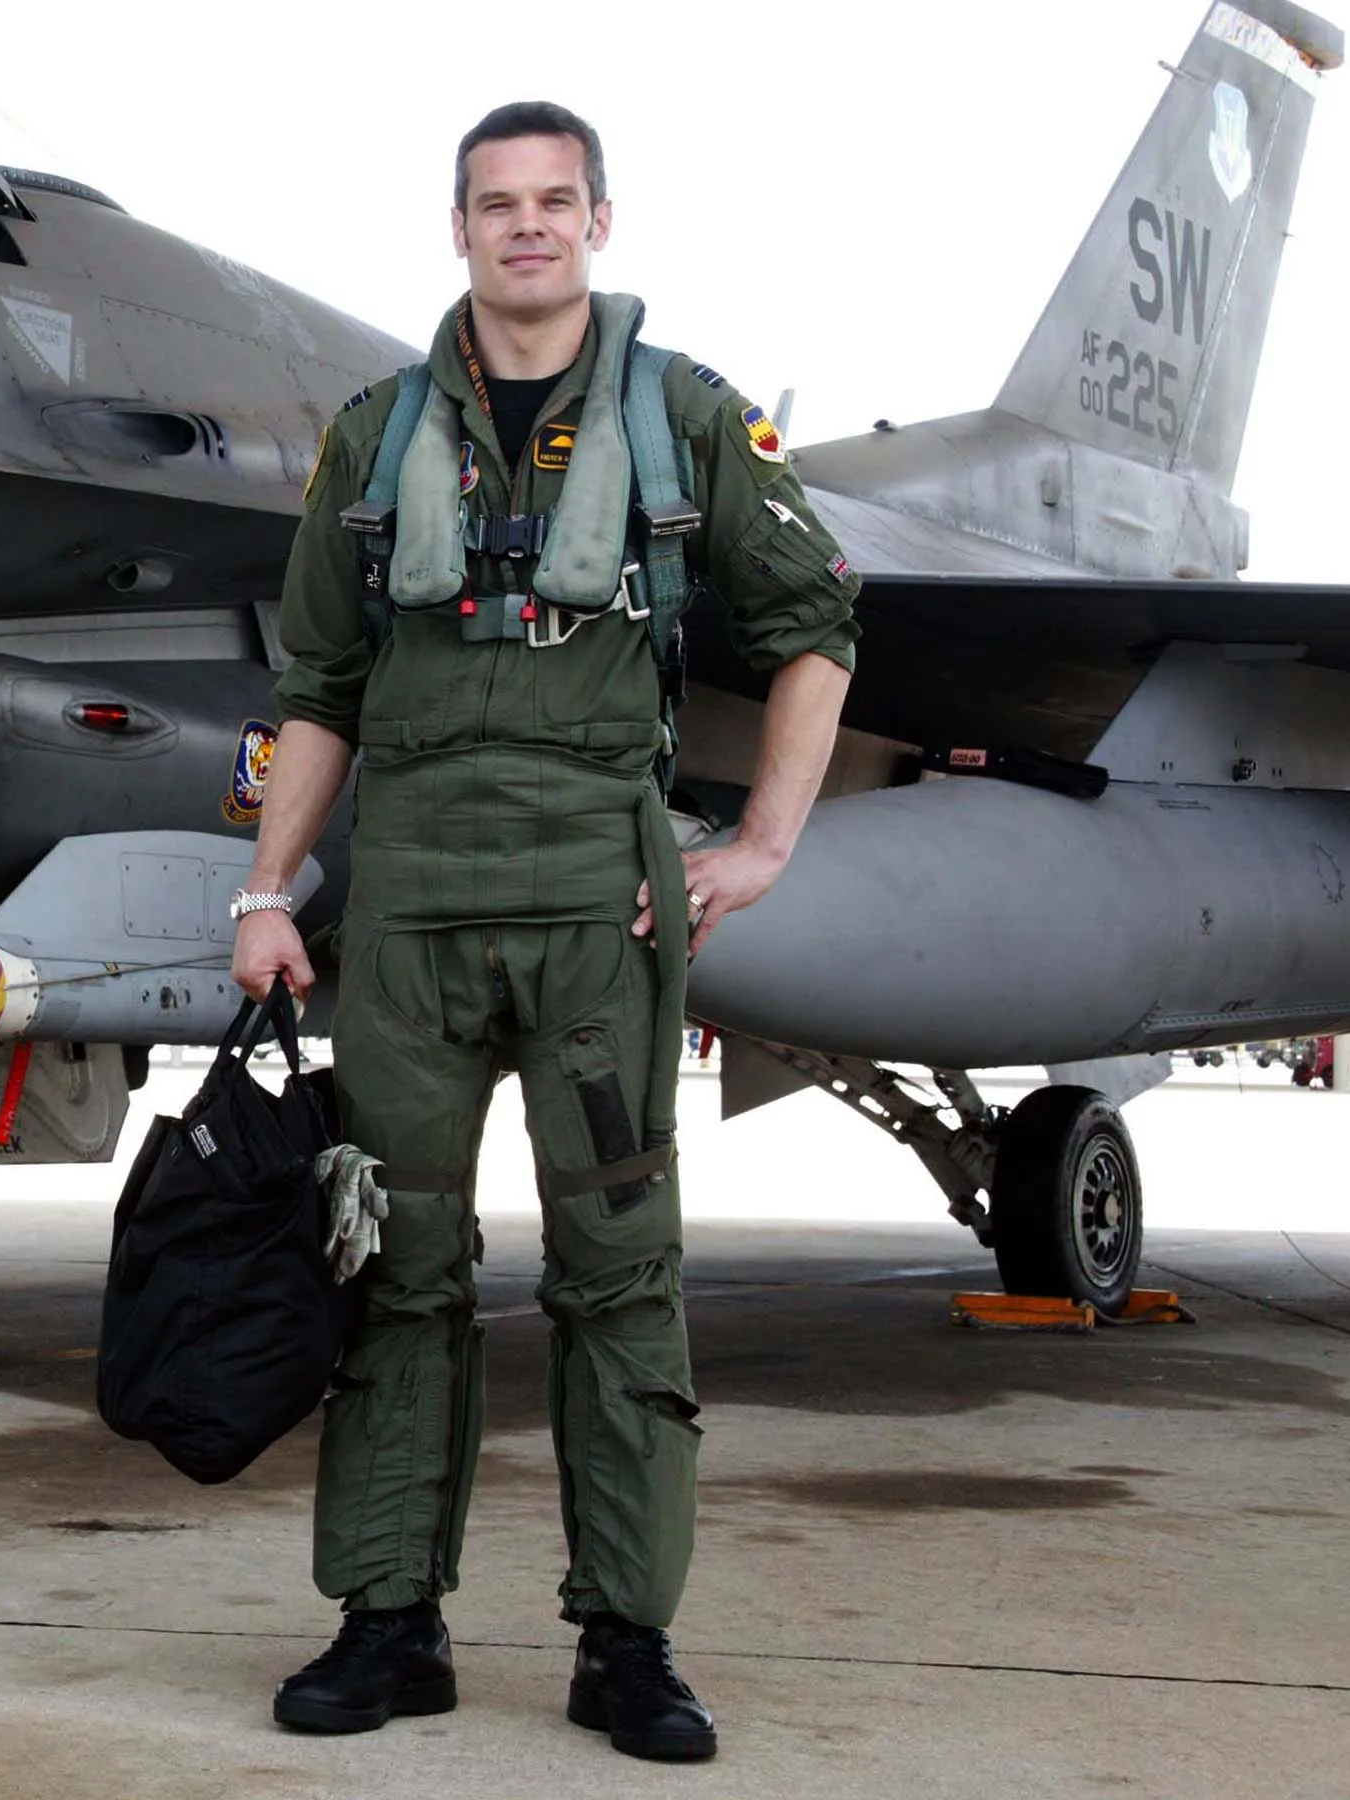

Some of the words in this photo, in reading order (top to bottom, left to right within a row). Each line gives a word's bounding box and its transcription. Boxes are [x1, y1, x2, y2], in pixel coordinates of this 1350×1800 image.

[1128, 197, 1211, 345] SW
[7, 316, 50, 374] DANGER
[1081, 329, 1102, 367] AF
[1080, 376, 1104, 416] 00
[1107, 340, 1178, 447] 225
